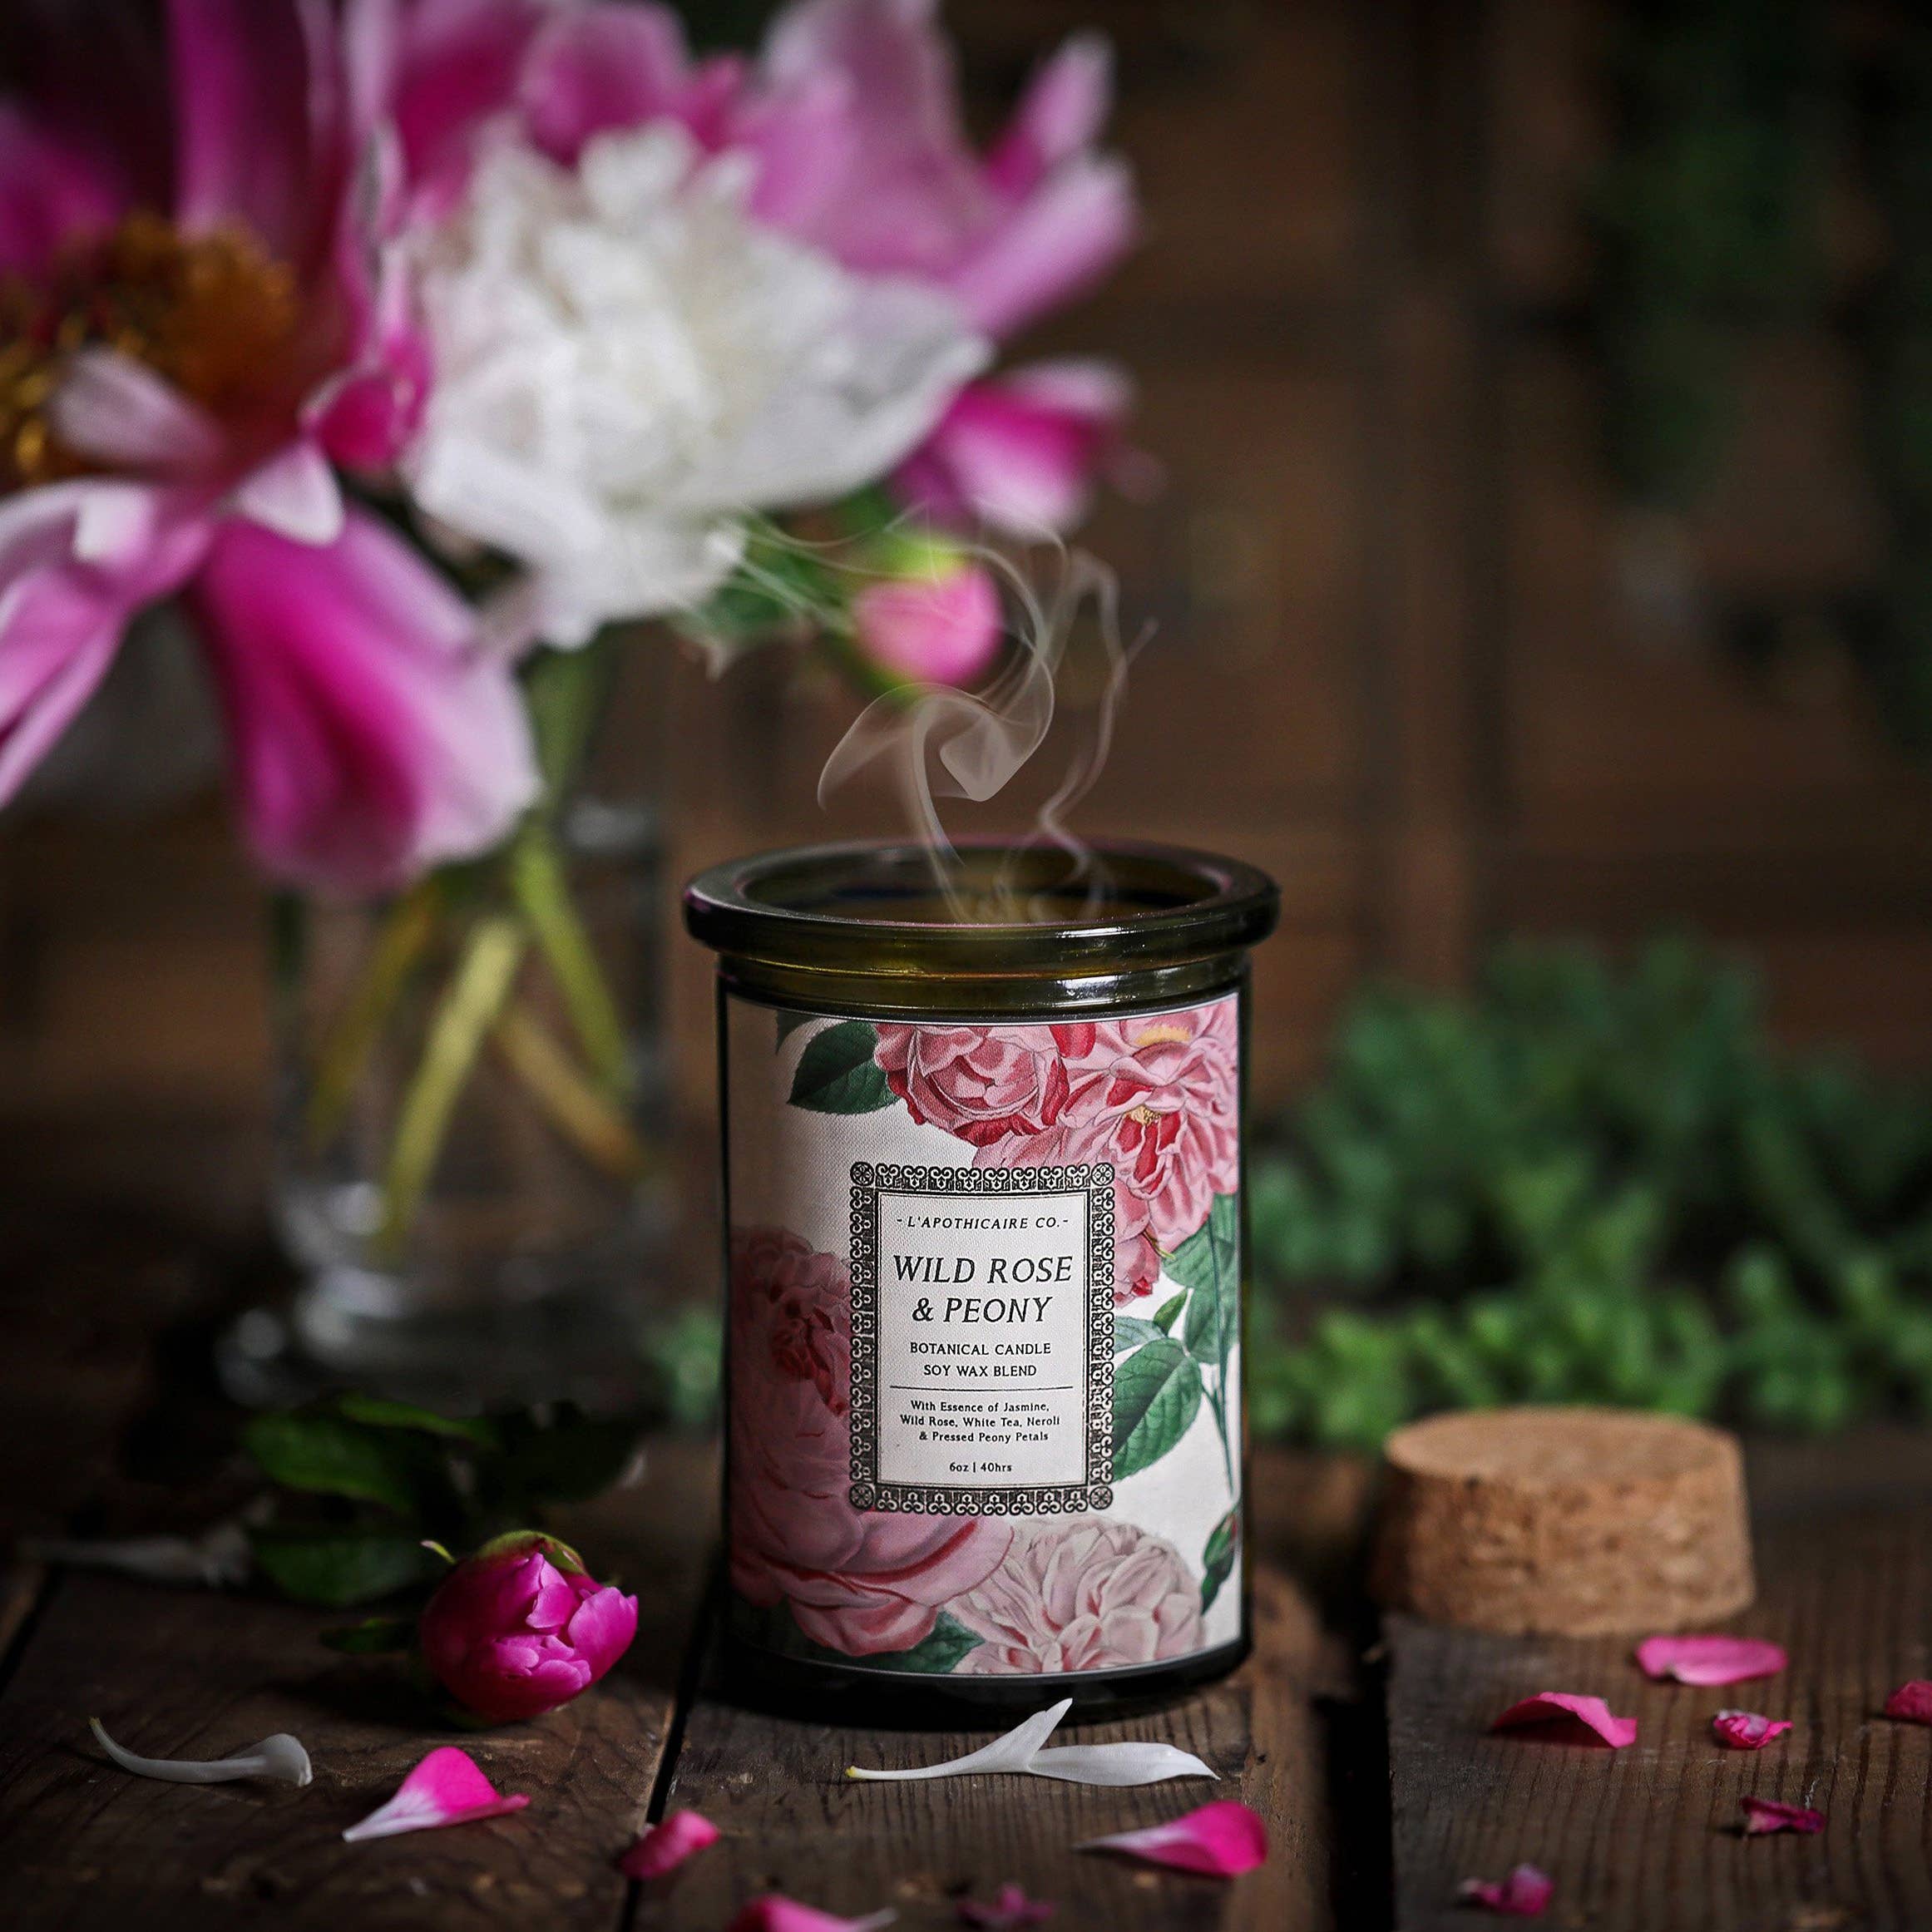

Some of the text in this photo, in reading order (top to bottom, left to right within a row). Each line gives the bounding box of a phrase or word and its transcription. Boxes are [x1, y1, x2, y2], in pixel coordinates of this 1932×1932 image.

[907, 1216, 1028, 1230] L'APOTHICAIRE
[893, 1253, 1073, 1285] WILD ROSE
[911, 1295, 1053, 1325] & PEONY
[909, 1342, 1050, 1356] BOTANICAL CANDLE
[923, 1363, 1036, 1377] SOY WAX BLEND
[909, 1400, 1049, 1412] With Essence of Jasmine,
[900, 1414, 1060, 1428] Wild Rose, White Tea, Neroli
[919, 1430, 1048, 1444] & Pressed Peony Petals
[950, 1462, 969, 1472] 6oz
[981, 1462, 1011, 1472] 40hrs
